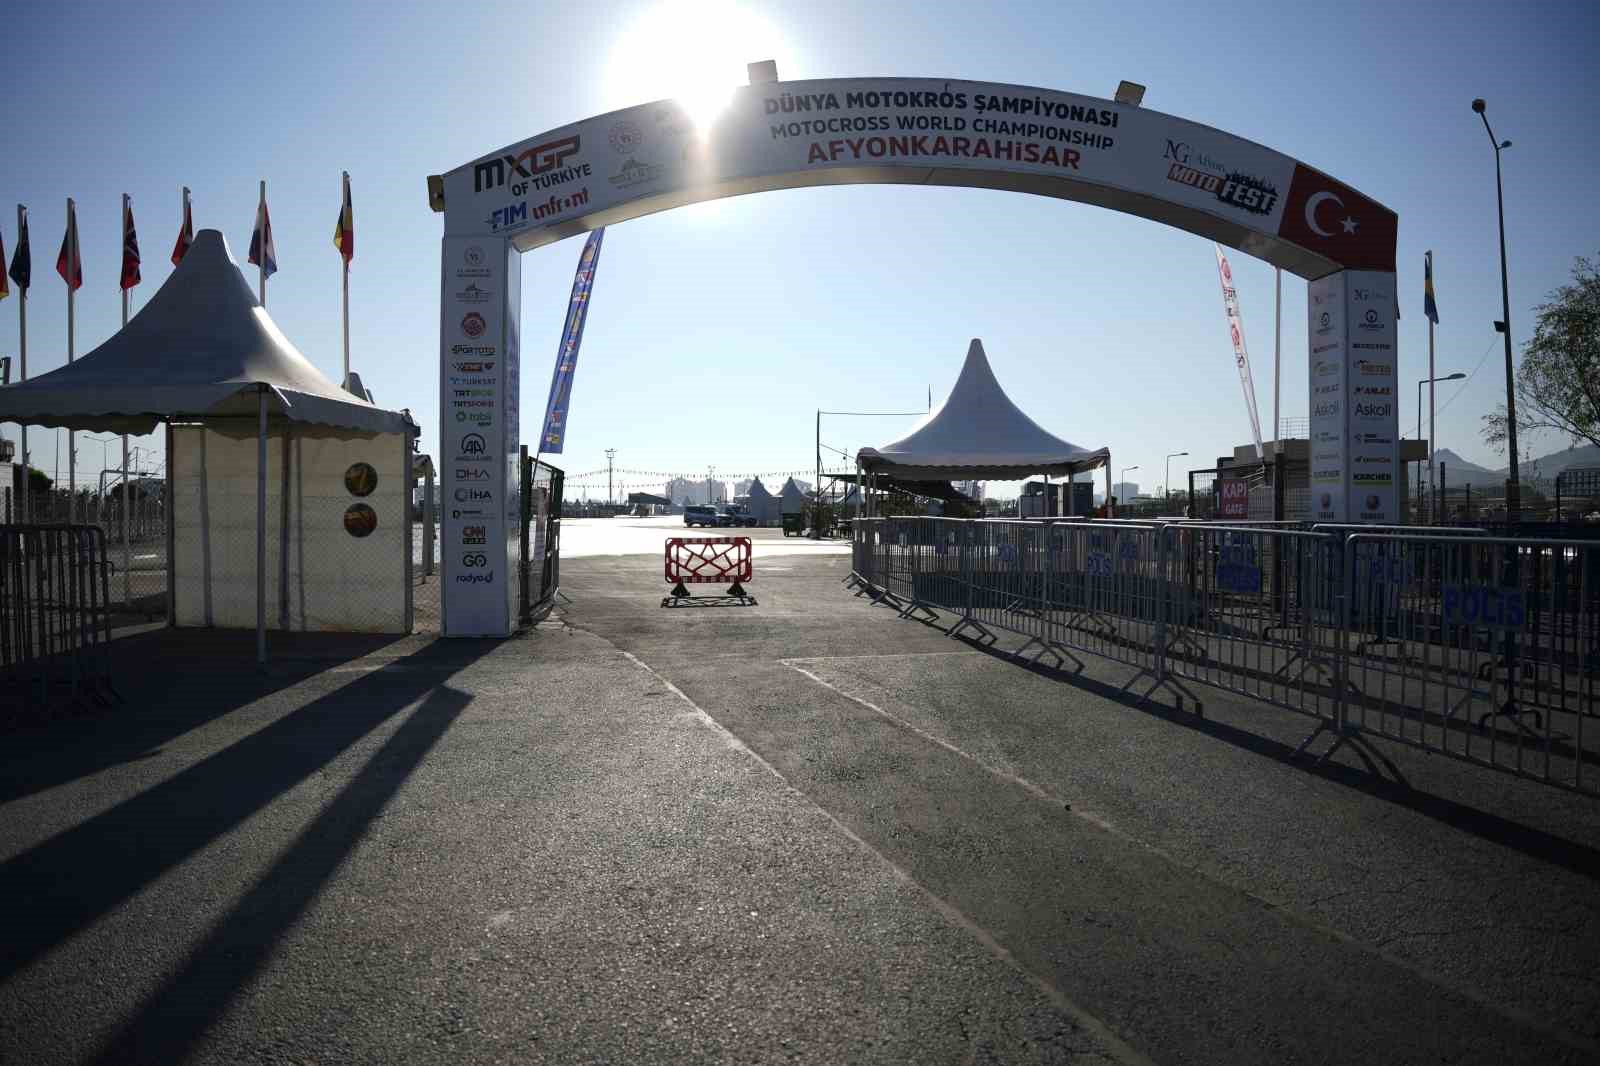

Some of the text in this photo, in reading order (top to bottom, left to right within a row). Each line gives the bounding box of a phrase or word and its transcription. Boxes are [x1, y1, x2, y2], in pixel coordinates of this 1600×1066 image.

[764, 90, 1119, 128] DÜNYA MOTOKRÖS ŞAMPİYONASI
[770, 115, 1114, 150] MOTOCROSS WORLD CHAMPIONSHIP
[474, 135, 580, 192] MXGP
[511, 182, 529, 196] OF
[1169, 164, 1280, 213] MOTO FEST
[490, 202, 528, 229] FIM
[1223, 483, 1247, 497] KAPI
